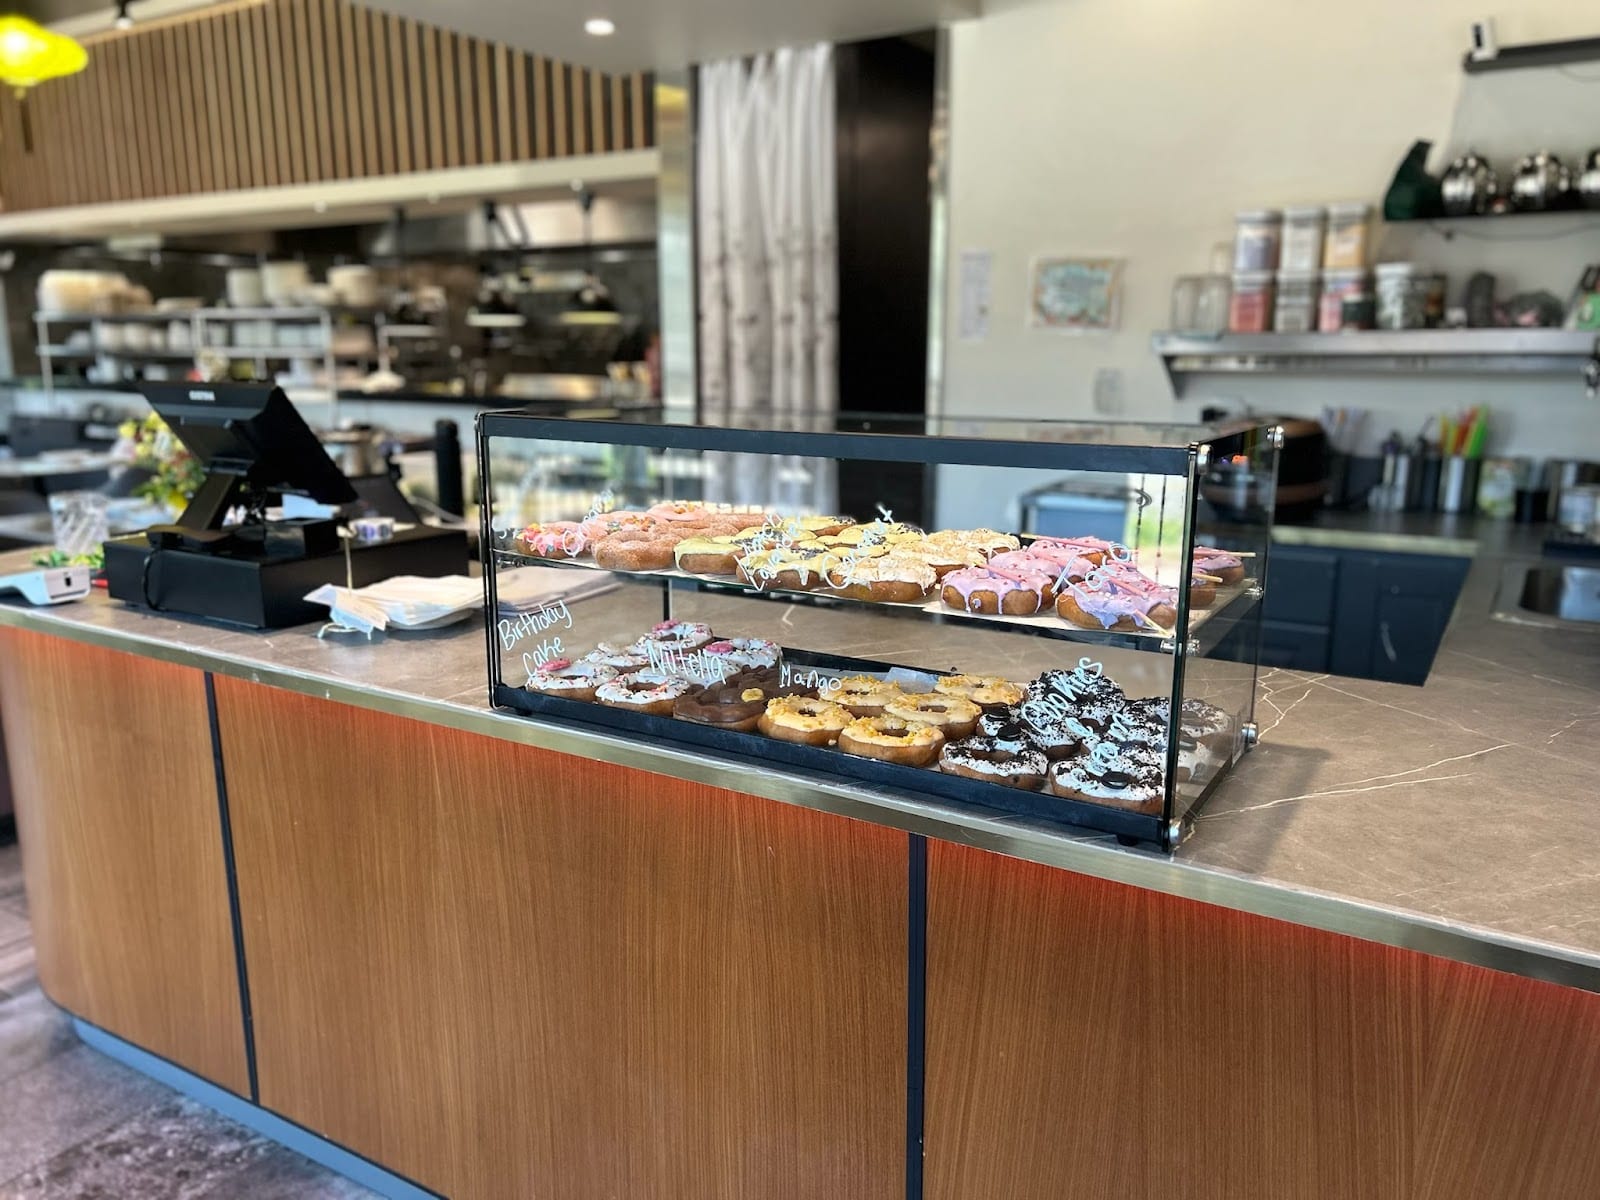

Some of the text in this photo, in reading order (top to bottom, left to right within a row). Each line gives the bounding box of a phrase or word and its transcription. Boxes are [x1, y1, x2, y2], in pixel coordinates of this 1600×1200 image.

[1050, 542, 1131, 602] Taro
[497, 599, 573, 651] Birthday
[522, 636, 566, 677] Cake
[779, 664, 842, 696] Mango
[1020, 656, 1103, 735] Cookies
